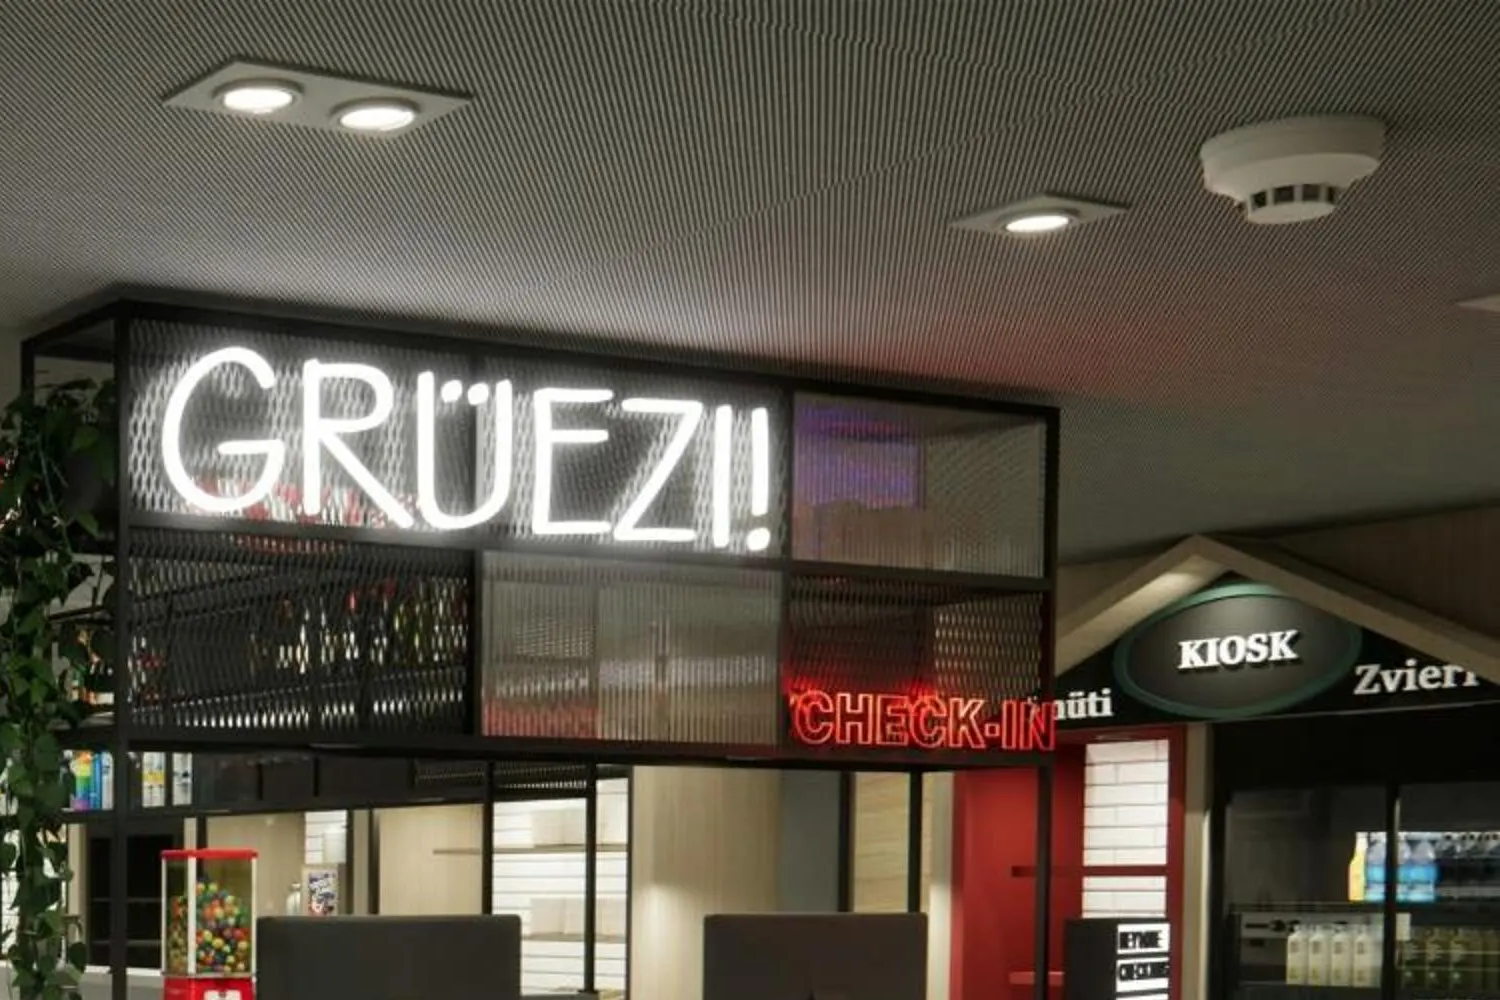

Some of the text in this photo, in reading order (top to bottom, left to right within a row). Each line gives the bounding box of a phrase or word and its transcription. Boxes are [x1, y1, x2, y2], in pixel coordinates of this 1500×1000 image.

[161, 346, 772, 551] GRÜEZI!
[1177, 629, 1299, 669] KIOSK
[793, 689, 1056, 750] CHECK-IN
